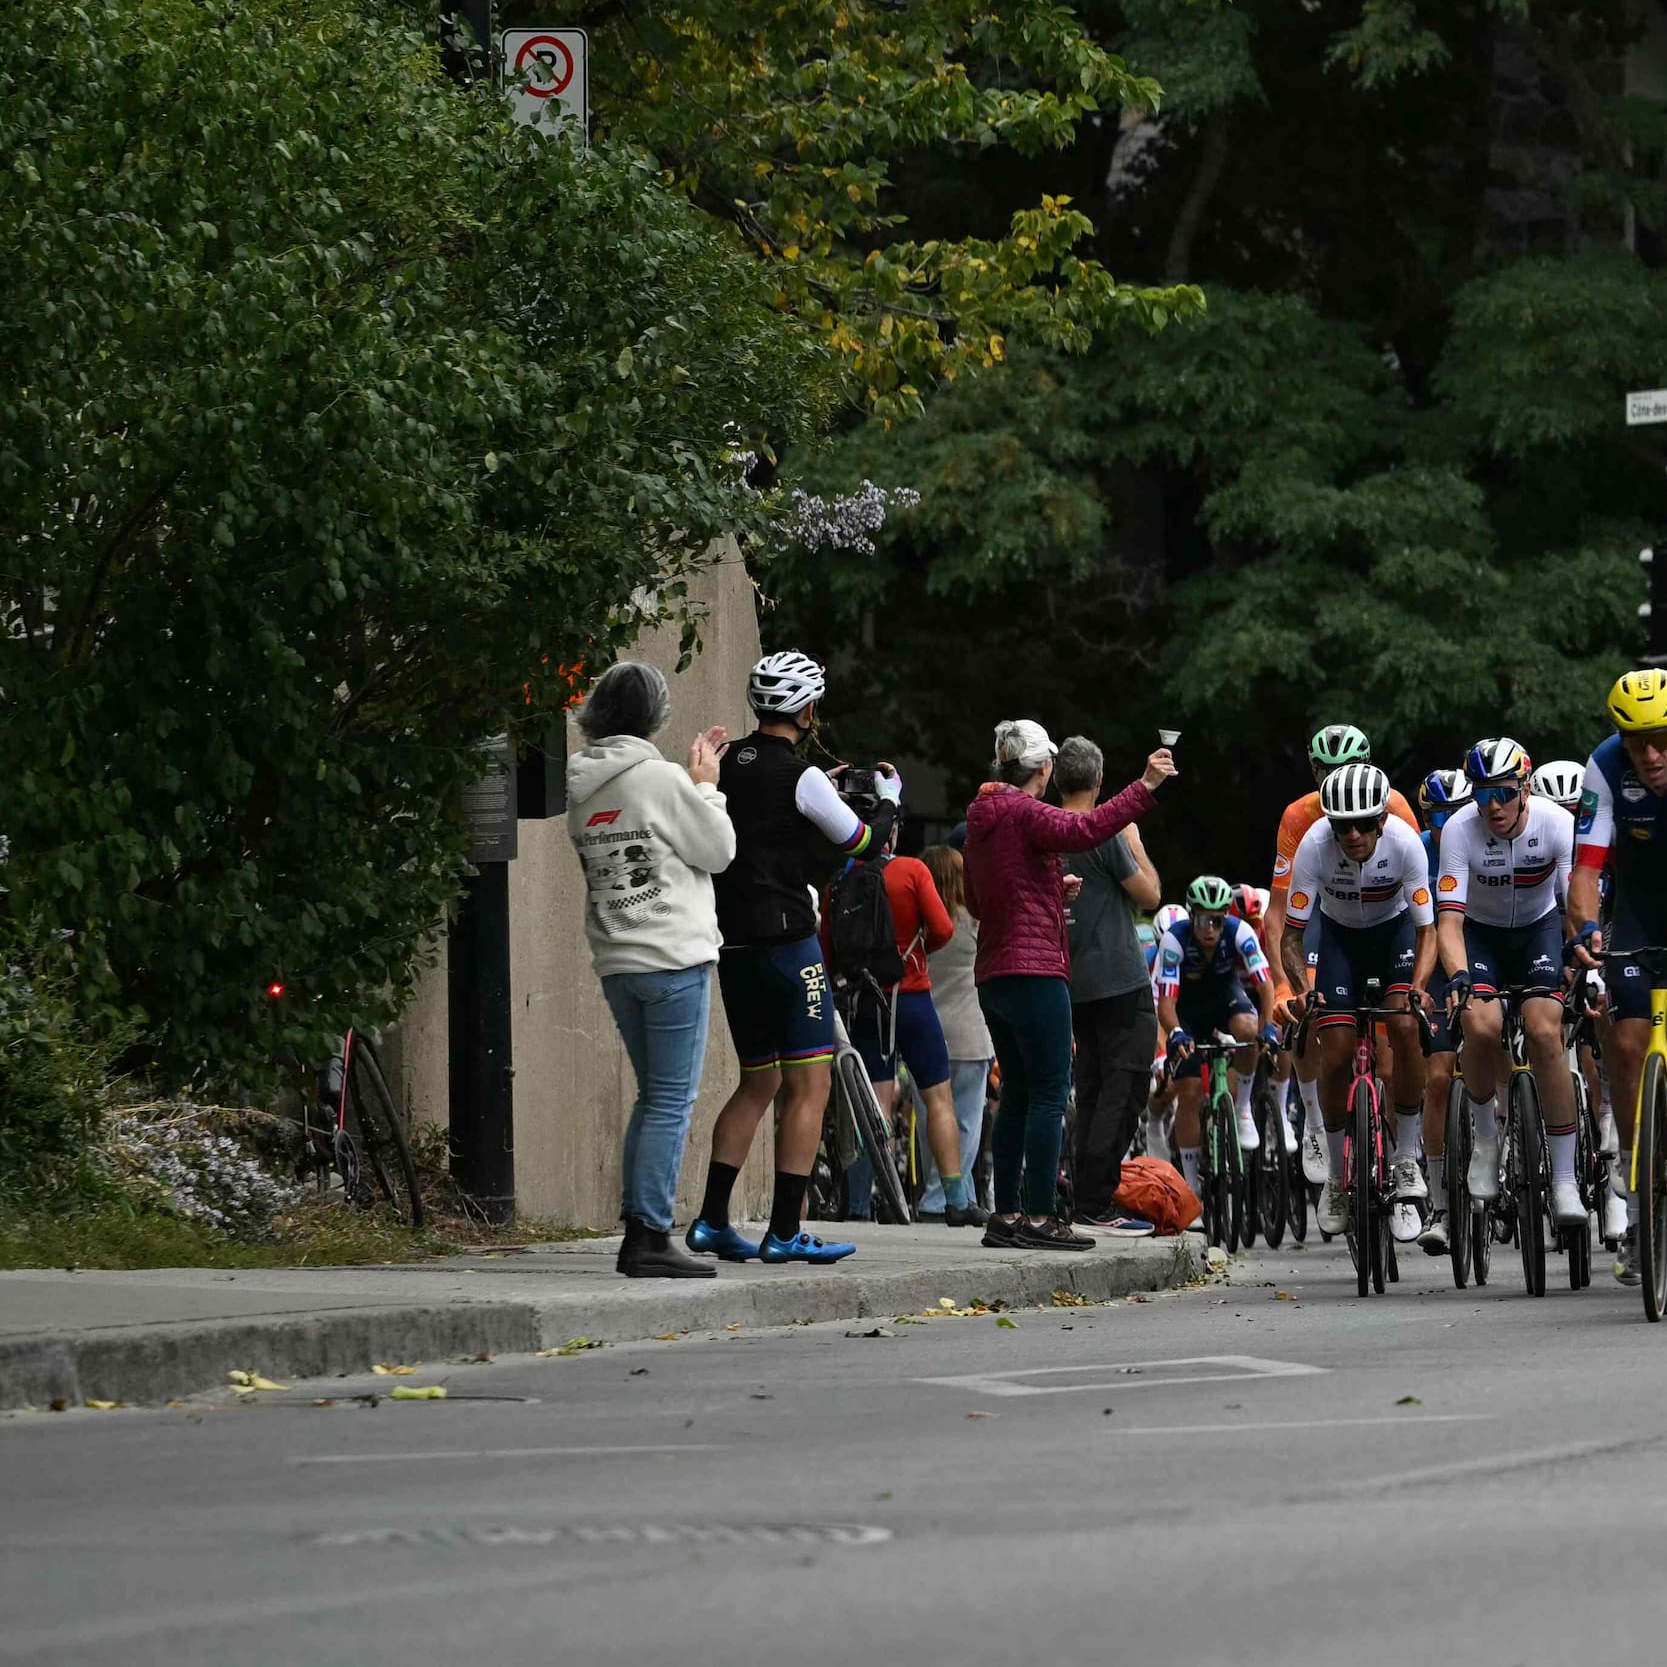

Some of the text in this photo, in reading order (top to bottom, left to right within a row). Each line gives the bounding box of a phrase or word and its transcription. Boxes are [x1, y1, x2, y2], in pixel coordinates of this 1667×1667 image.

[1477, 874, 1513, 887] GBR
[1394, 961, 1415, 969] LLOY
[1528, 964, 1556, 975] LLOYDS
[814, 962, 827, 993] PIT
[800, 965, 823, 1021] CREW
